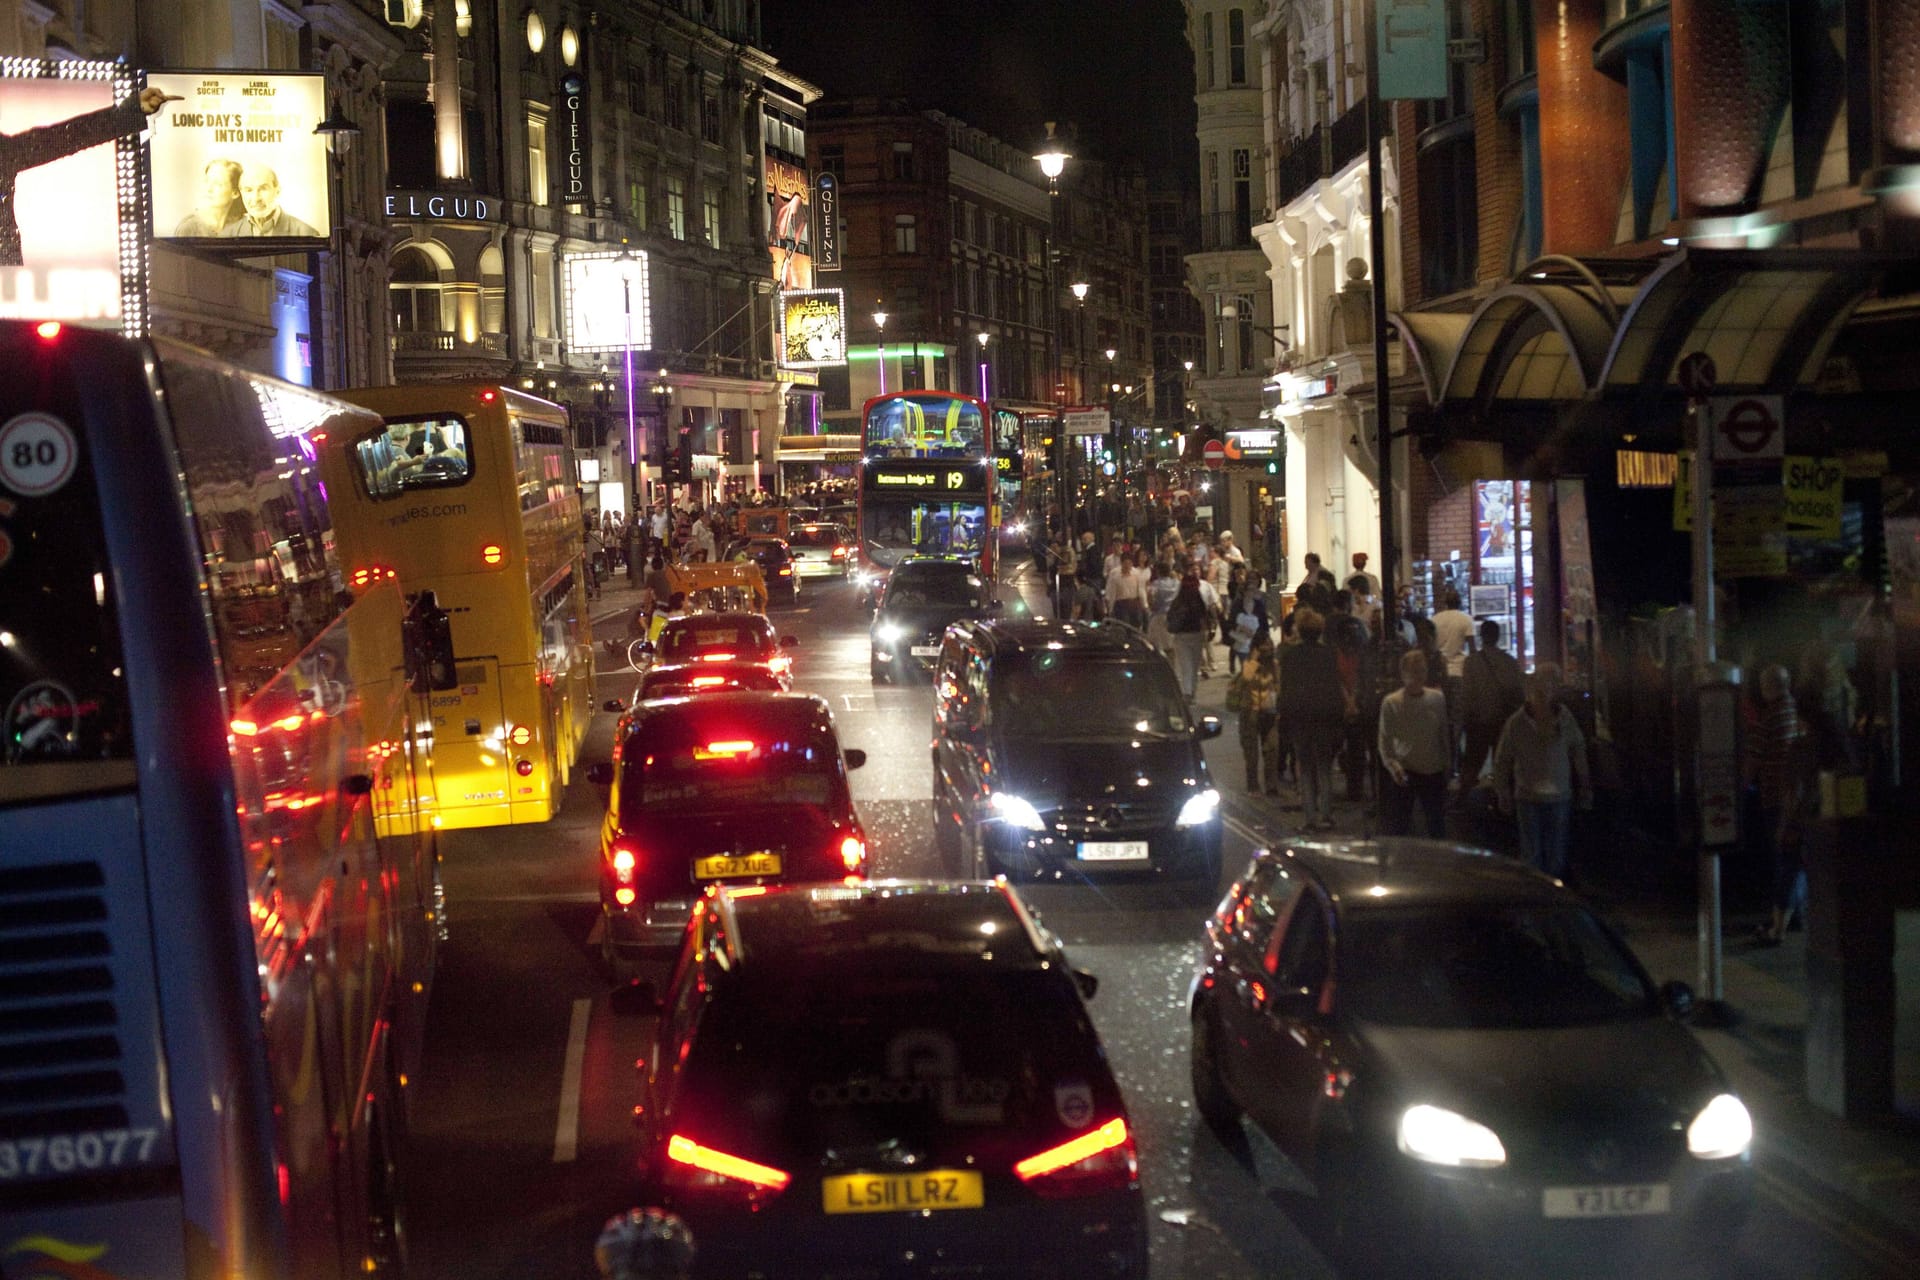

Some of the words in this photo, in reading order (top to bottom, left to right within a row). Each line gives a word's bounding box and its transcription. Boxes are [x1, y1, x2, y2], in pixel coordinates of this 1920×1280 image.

[242, 88, 277, 96] METCALF
[172, 113, 204, 127] LONG
[206, 113, 242, 127] DAY'S
[215, 129, 244, 143] INTO
[246, 129, 283, 143] NIGHT
[567, 96, 583, 193] GIELGUD
[821, 190, 834, 262] QUEENS
[805, 296, 818, 306] Les
[1690, 359, 1708, 386] K
[12, 439, 57, 469] 80
[997, 458, 1011, 469] 38
[947, 472, 964, 489] 19
[1791, 464, 1841, 491] SHOP
[1785, 500, 1833, 518] hotos
[705, 860, 737, 875] LS12
[743, 858, 771, 872] XUE
[846, 1180, 896, 1206] LS11
[905, 1178, 960, 1203] LRZ
